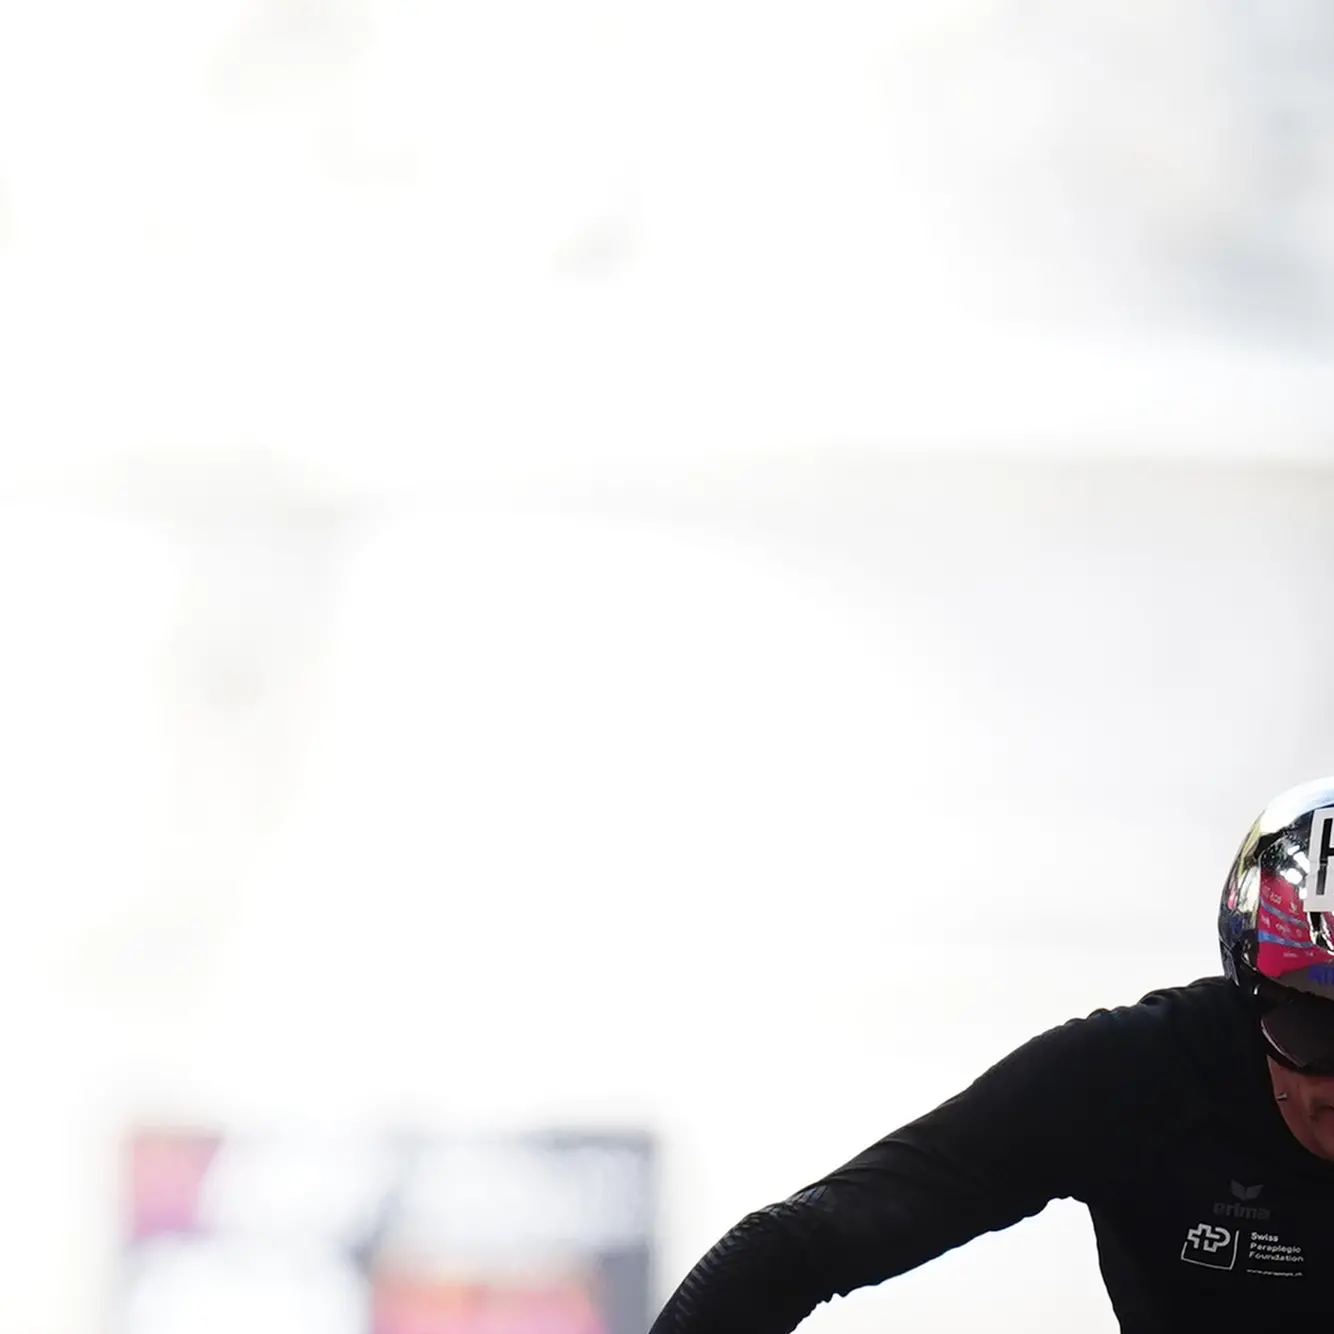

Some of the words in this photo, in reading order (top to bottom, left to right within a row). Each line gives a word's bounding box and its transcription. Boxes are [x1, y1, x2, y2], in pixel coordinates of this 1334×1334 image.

[1213, 1201, 1272, 1220] erima
[1250, 1231, 1279, 1242] Swiss
[1248, 1250, 1305, 1263] Foundation
